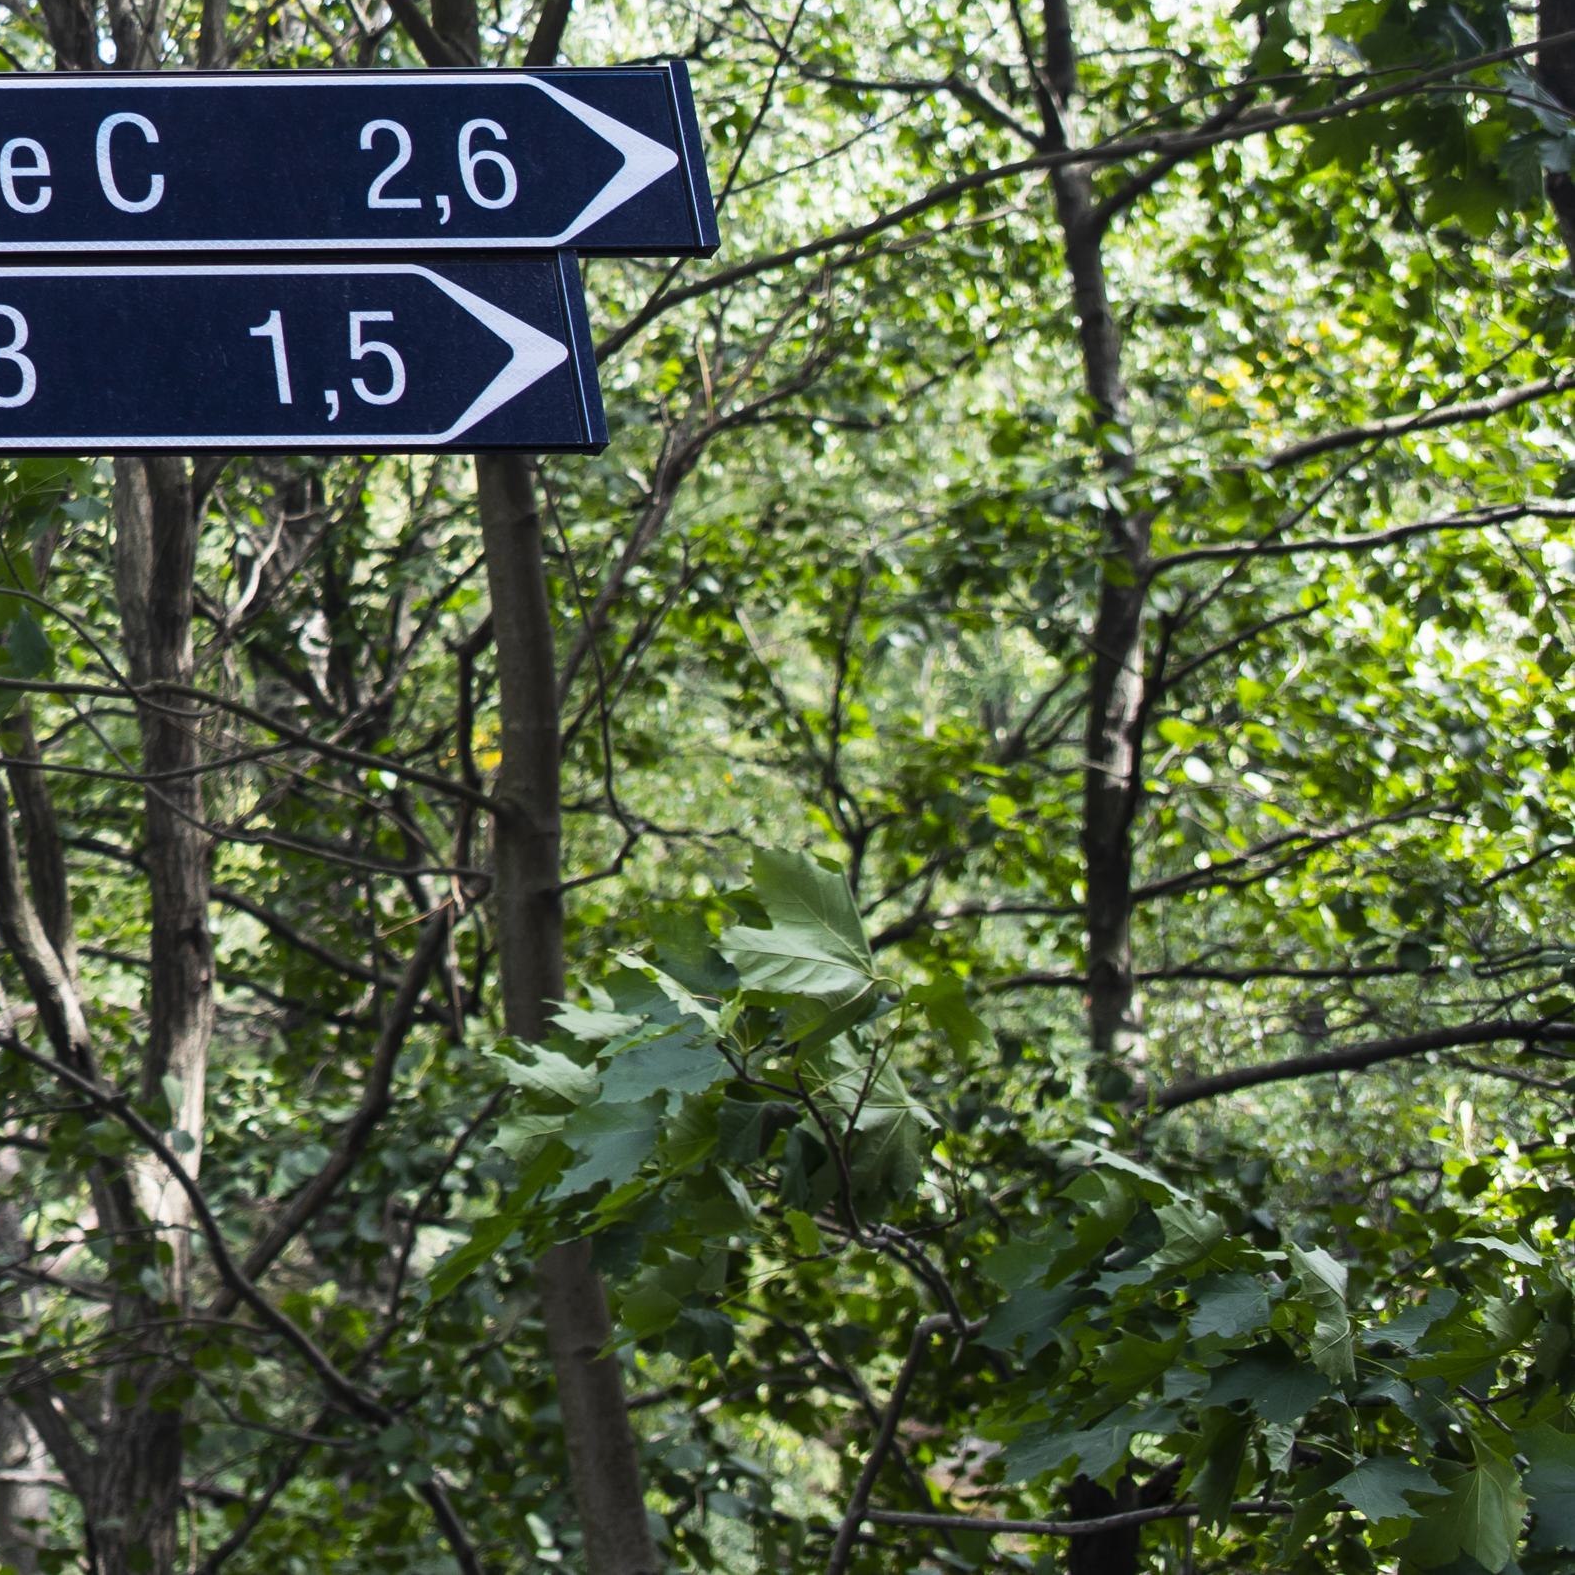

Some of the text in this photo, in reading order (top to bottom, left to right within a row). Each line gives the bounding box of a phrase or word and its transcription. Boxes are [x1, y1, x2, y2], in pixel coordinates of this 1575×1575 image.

[95, 112, 165, 214] C
[359, 118, 518, 225] 2,6
[249, 310, 406, 421] 1,5
